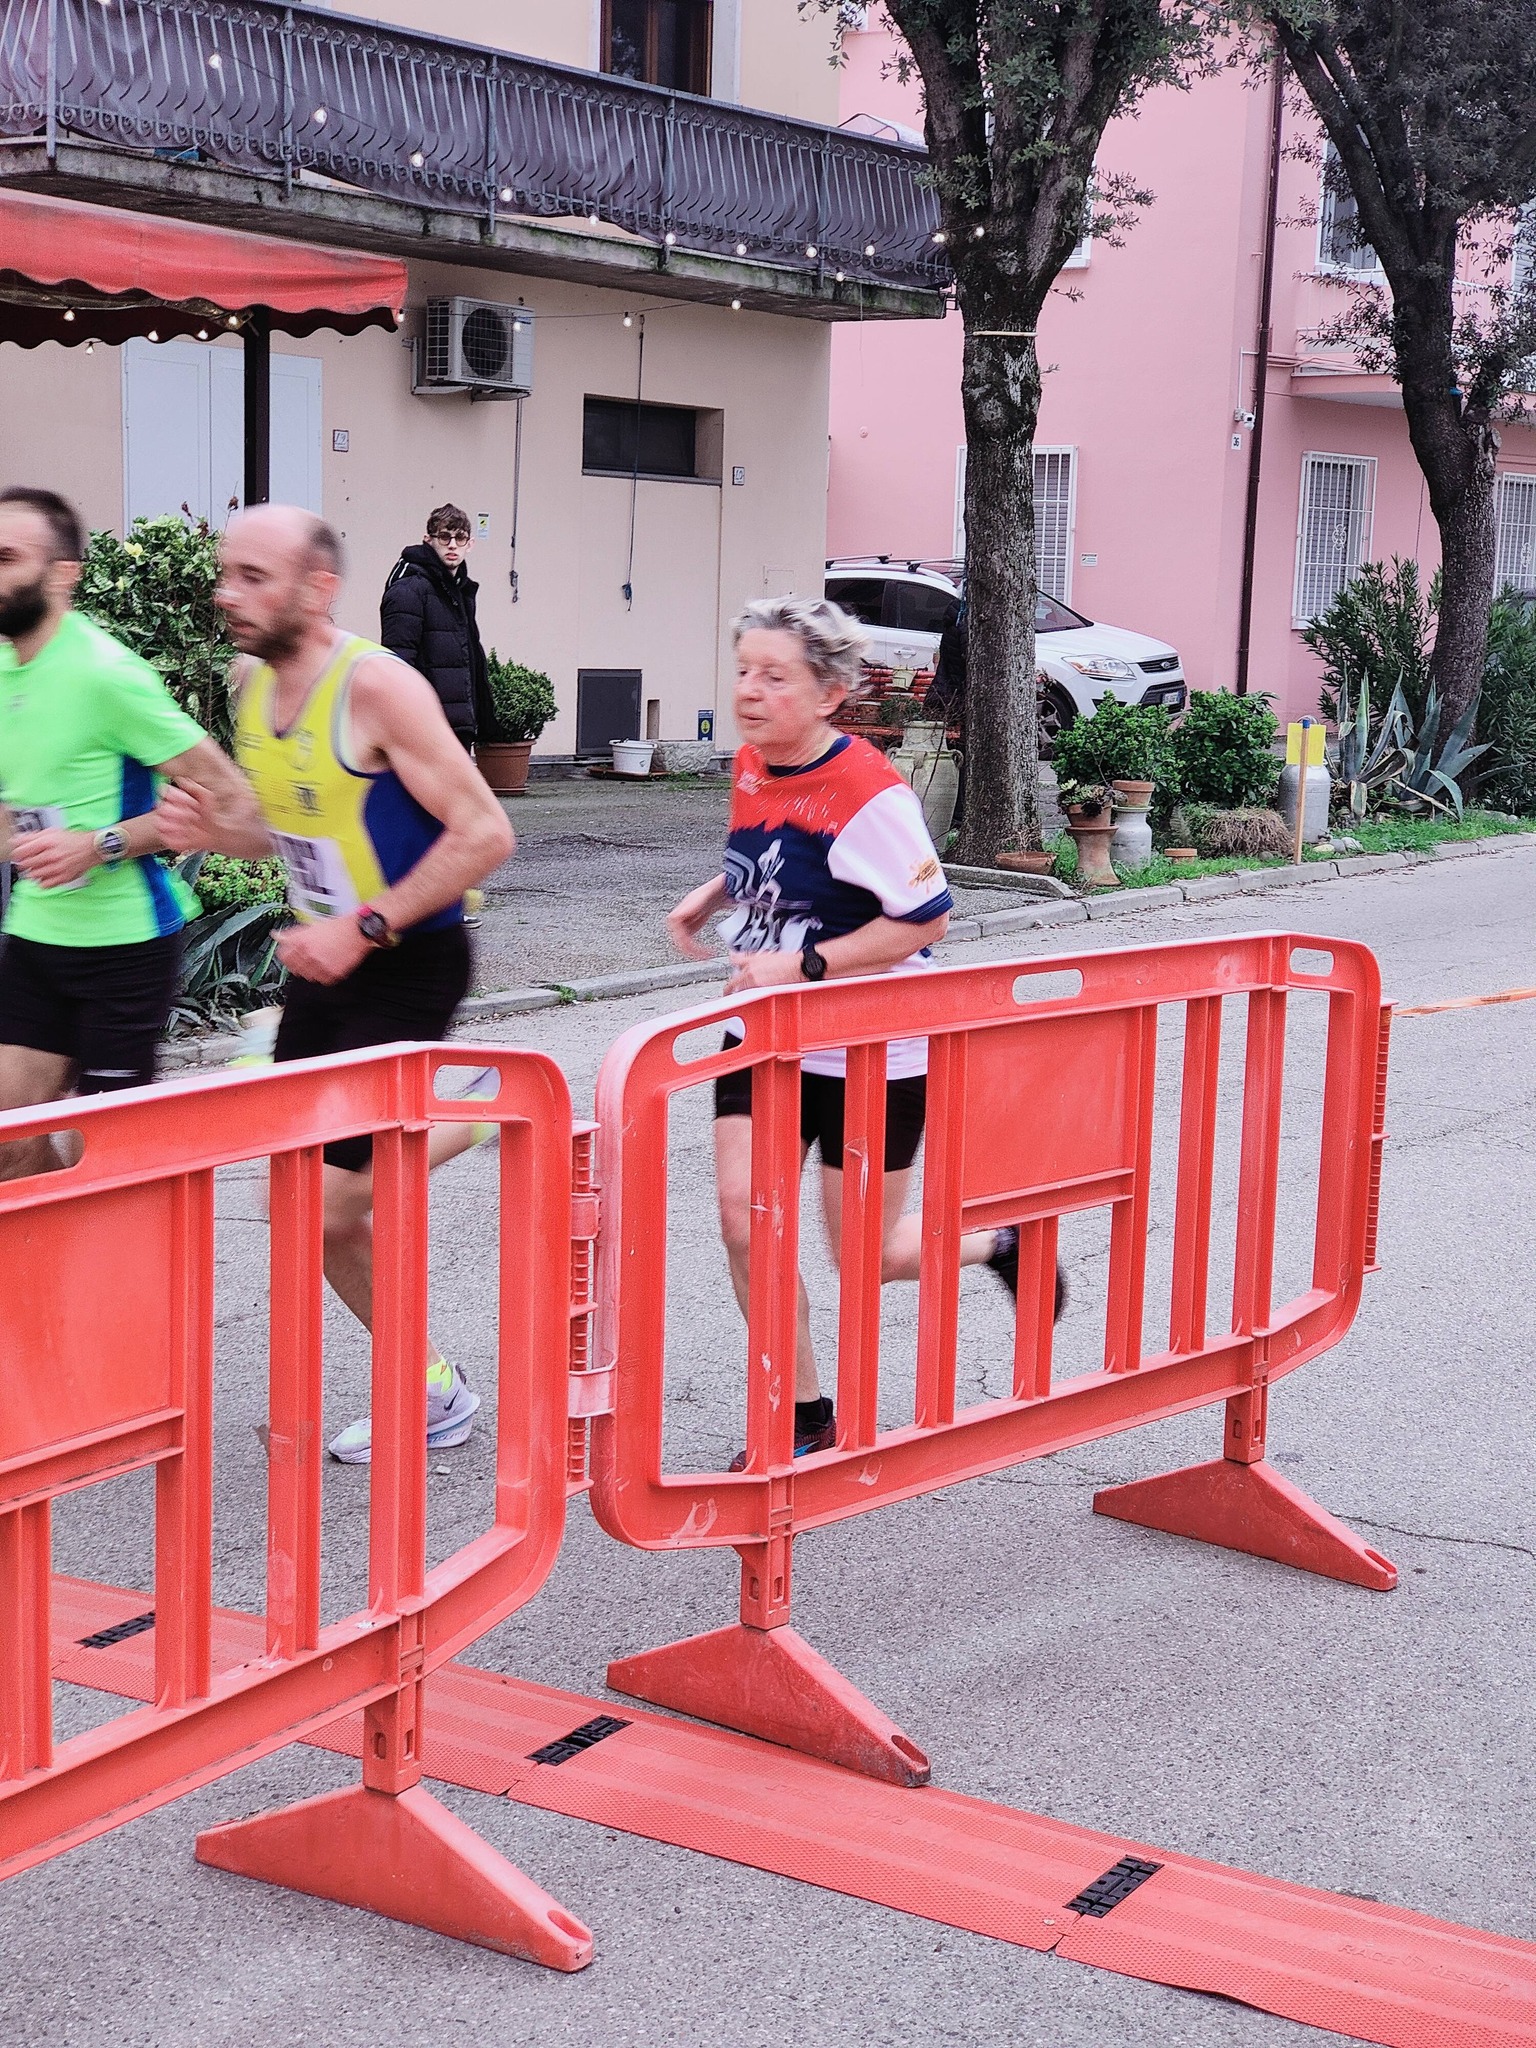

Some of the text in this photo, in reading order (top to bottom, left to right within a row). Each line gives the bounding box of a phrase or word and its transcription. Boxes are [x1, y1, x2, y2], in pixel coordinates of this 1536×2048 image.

[1233, 436, 1240, 447] 36
[1338, 1944, 1511, 1992] RACE RESULT
